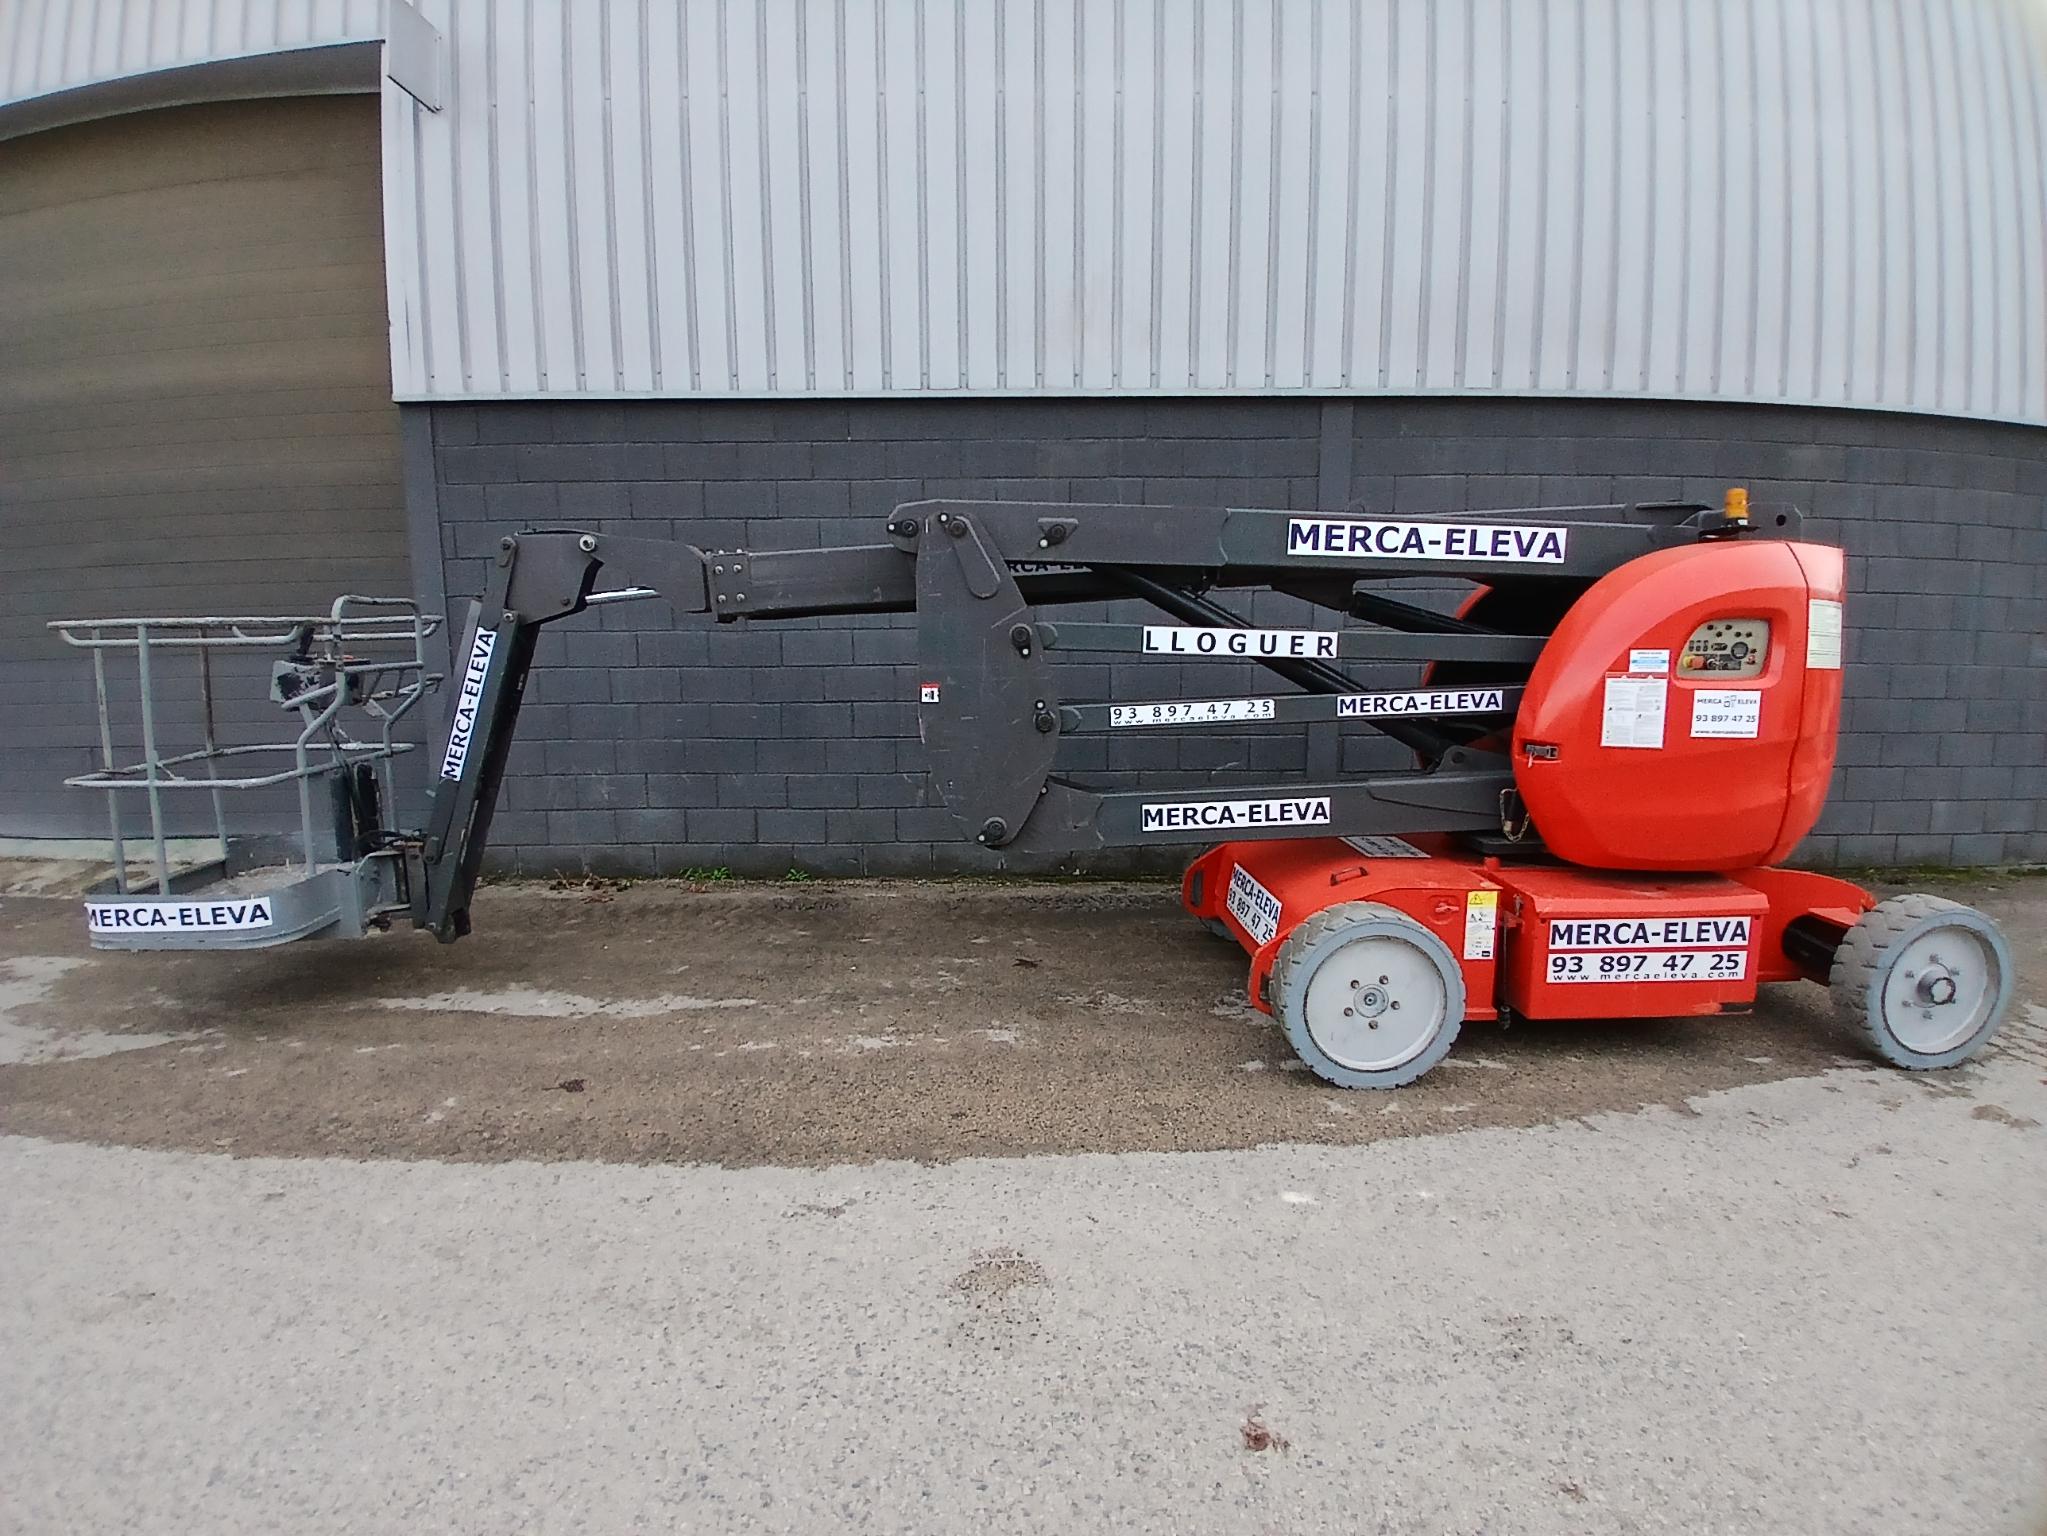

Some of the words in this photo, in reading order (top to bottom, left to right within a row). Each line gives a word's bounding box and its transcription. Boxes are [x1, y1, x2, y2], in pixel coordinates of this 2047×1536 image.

[1290, 523, 1562, 559] MERCA-ELEVA
[1145, 630, 1334, 657] LLOGUER
[444, 632, 494, 779] MERCA-ELEVA
[1113, 707, 1137, 720] 93
[1153, 704, 1192, 718] 897
[1208, 703, 1232, 715] 47
[1248, 701, 1271, 713] 25
[1339, 692, 1500, 714] MERCA-ELEVA
[1746, 715, 1756, 723] 25
[1143, 801, 1329, 828] MERCA-ELEVA
[1232, 867, 1280, 923] MERCA-ELEVA
[1236, 897, 1251, 918] 897
[1250, 912, 1261, 930] 47
[1262, 923, 1274, 942] 25
[1550, 920, 1747, 945] MERCA-ELEVA
[1552, 956, 1584, 973] 93
[1599, 955, 1648, 972] 897
[1662, 954, 1695, 971] 47
[1709, 953, 1740, 970] 25
